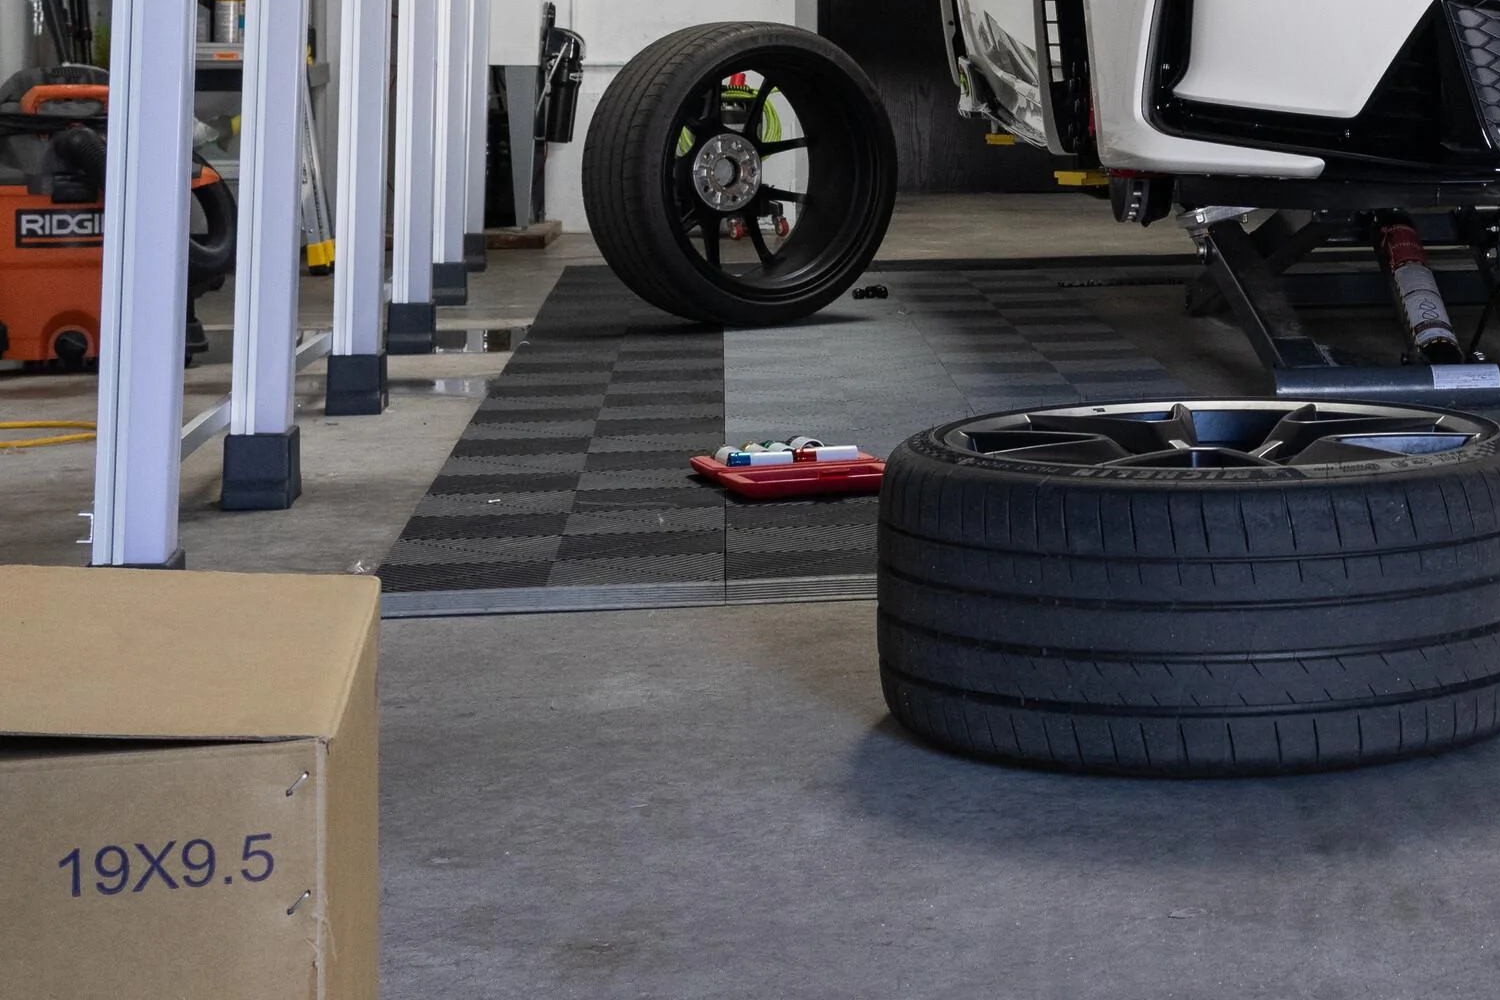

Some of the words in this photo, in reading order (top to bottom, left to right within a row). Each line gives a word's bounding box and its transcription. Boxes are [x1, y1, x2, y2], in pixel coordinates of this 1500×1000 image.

[20, 213, 105, 235] RIDGI
[1069, 467, 1251, 480] MICHELIN
[58, 833, 275, 899] 19X9.5
